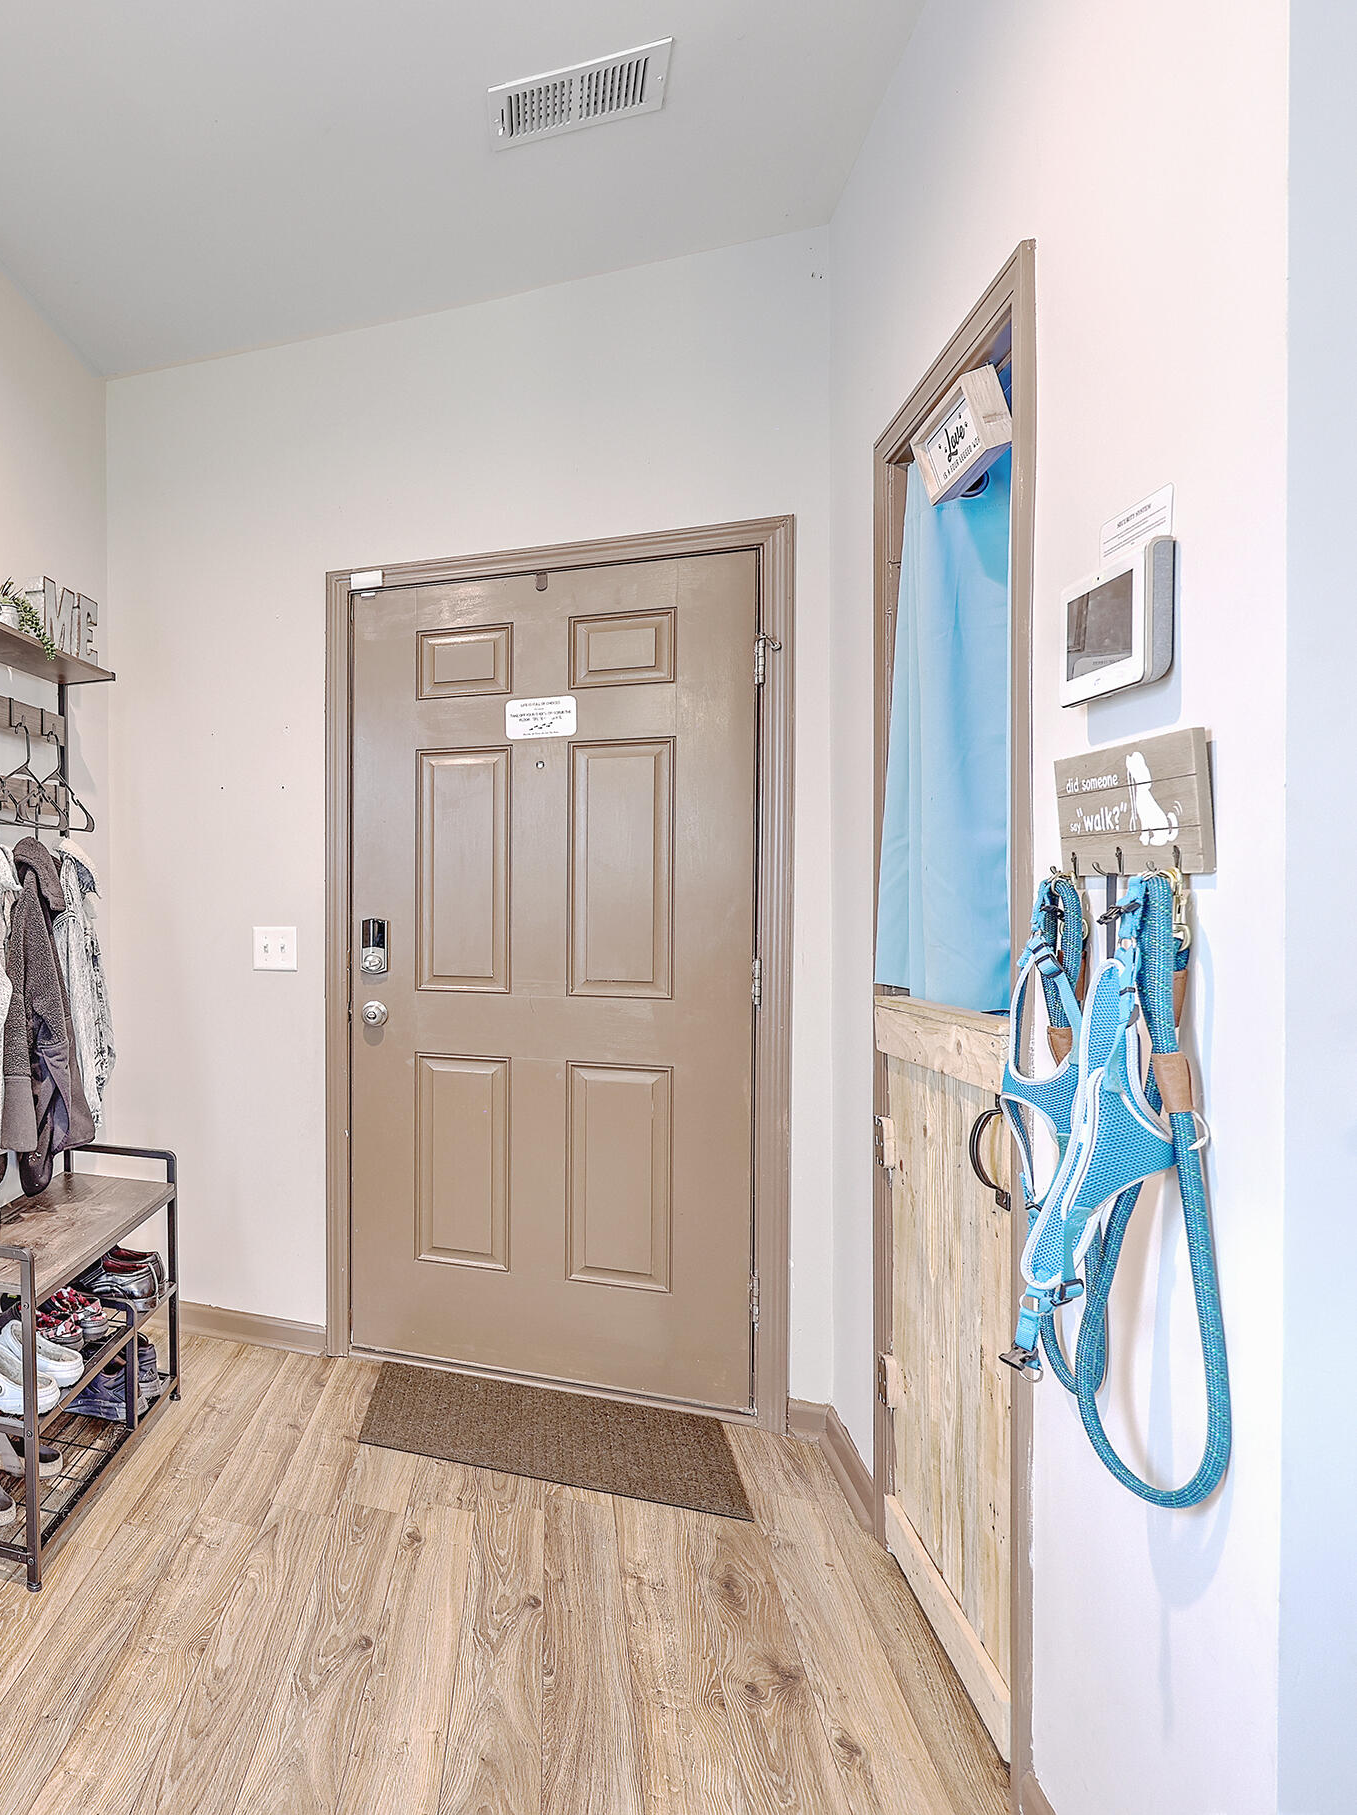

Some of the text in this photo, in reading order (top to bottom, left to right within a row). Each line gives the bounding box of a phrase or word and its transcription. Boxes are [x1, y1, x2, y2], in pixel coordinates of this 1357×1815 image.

[944, 425, 965, 463] Love
[1065, 774, 1119, 793] did someone
[1069, 801, 1128, 834] say "walk?"
